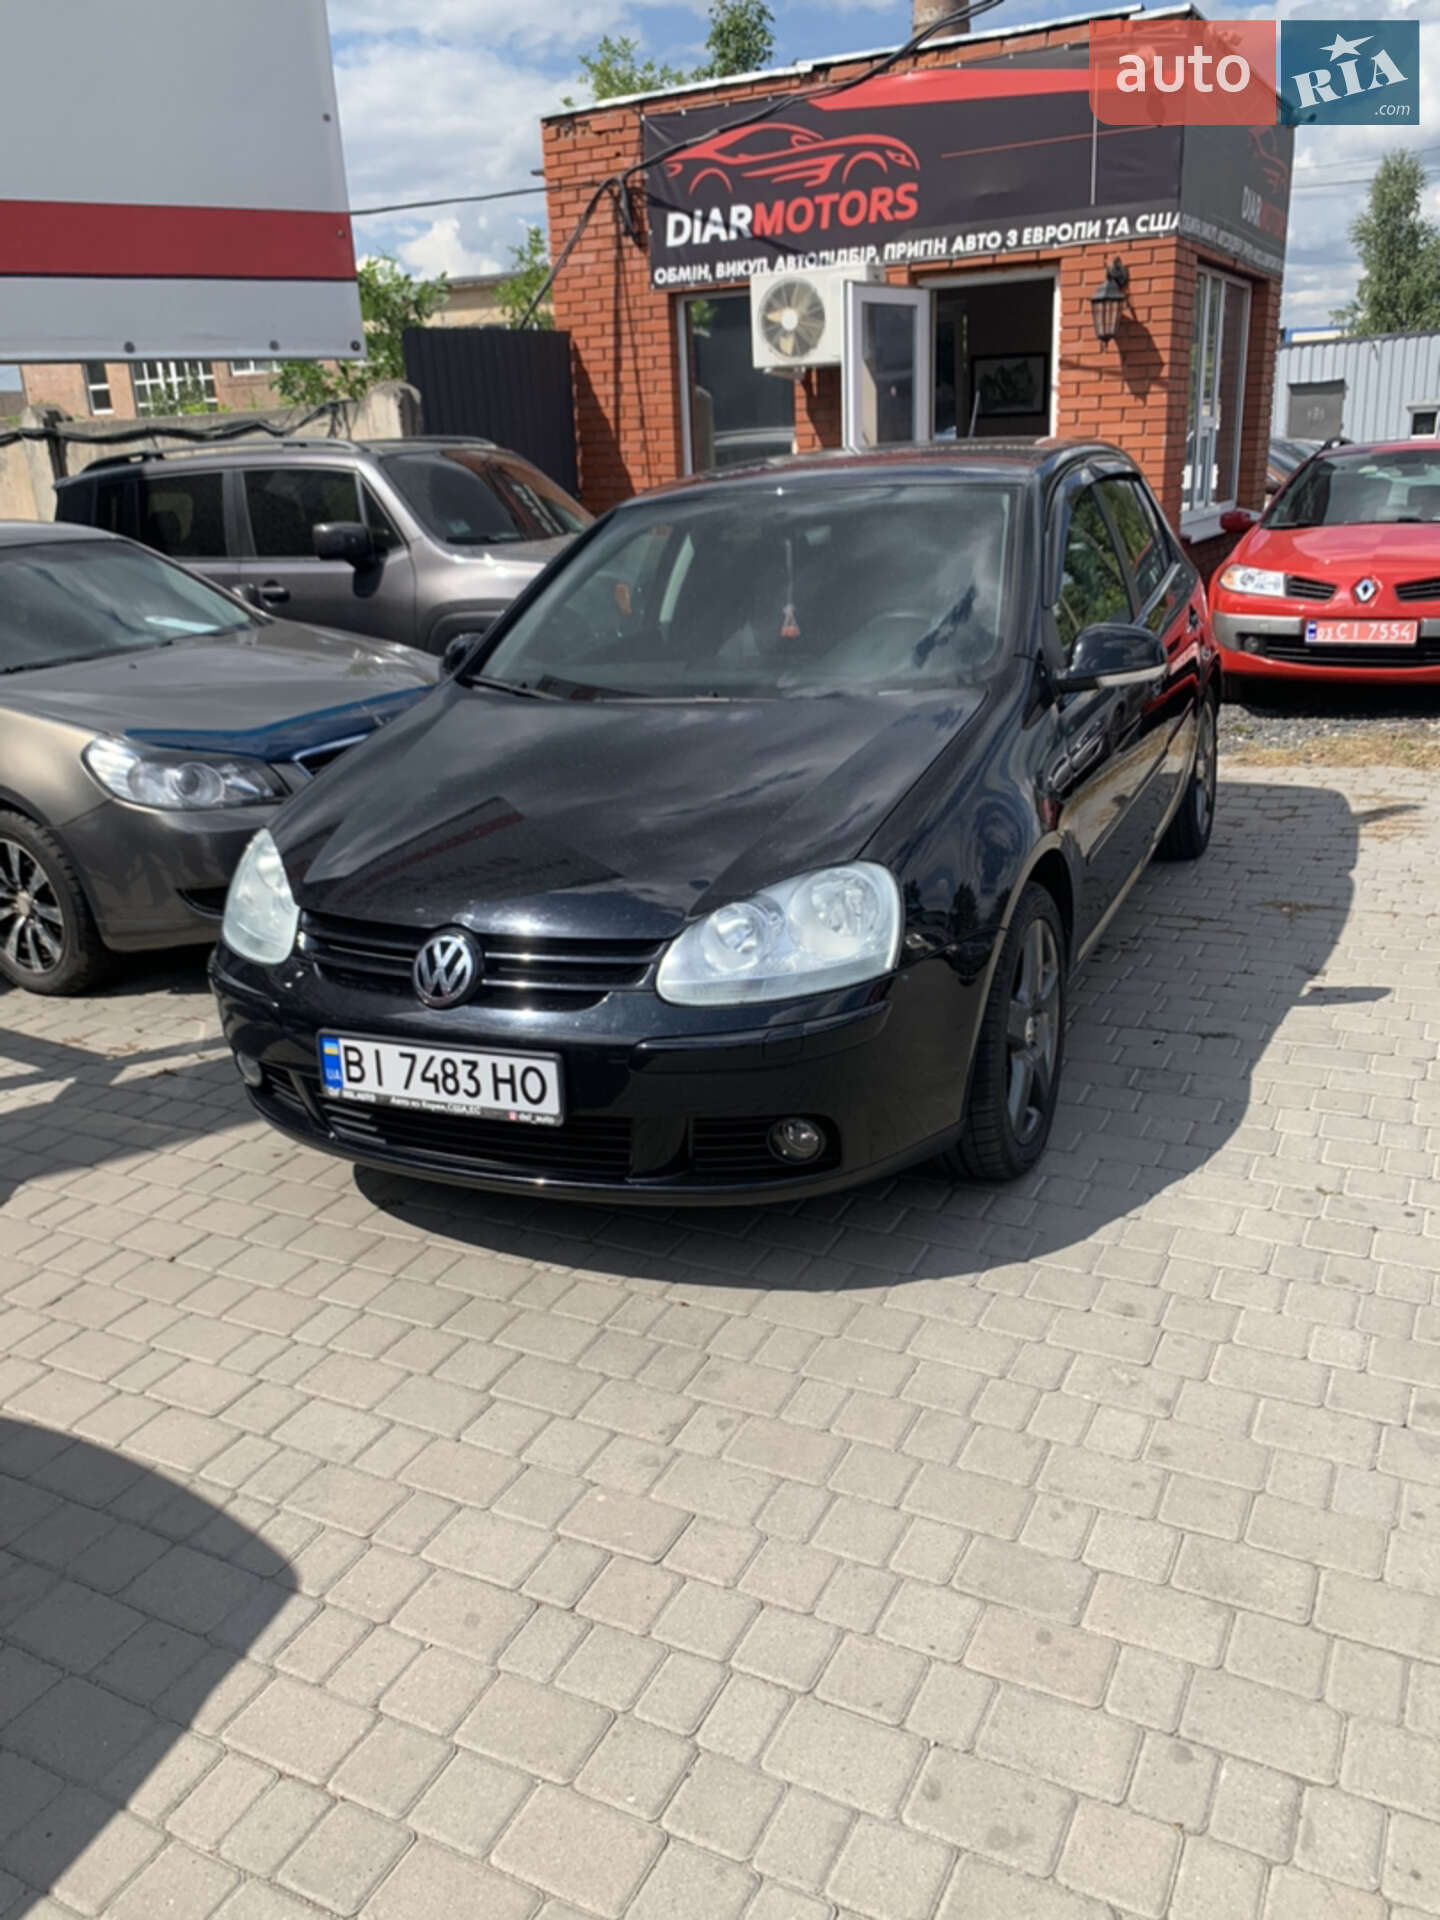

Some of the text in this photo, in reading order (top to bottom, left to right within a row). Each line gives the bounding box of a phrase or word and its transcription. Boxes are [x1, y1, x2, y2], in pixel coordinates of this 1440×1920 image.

[653, 262, 713, 285] ОБМІН,
[884, 236, 948, 261] ПРИГІН
[951, 231, 1002, 253] АВТО
[1021, 220, 1101, 244] ЕВРОПИ
[1106, 216, 1130, 237] ТА
[1368, 622, 1410, 641] 7554
[343, 1045, 383, 1087] BI
[399, 1051, 482, 1099] 7483
[491, 1061, 548, 1106] HO
